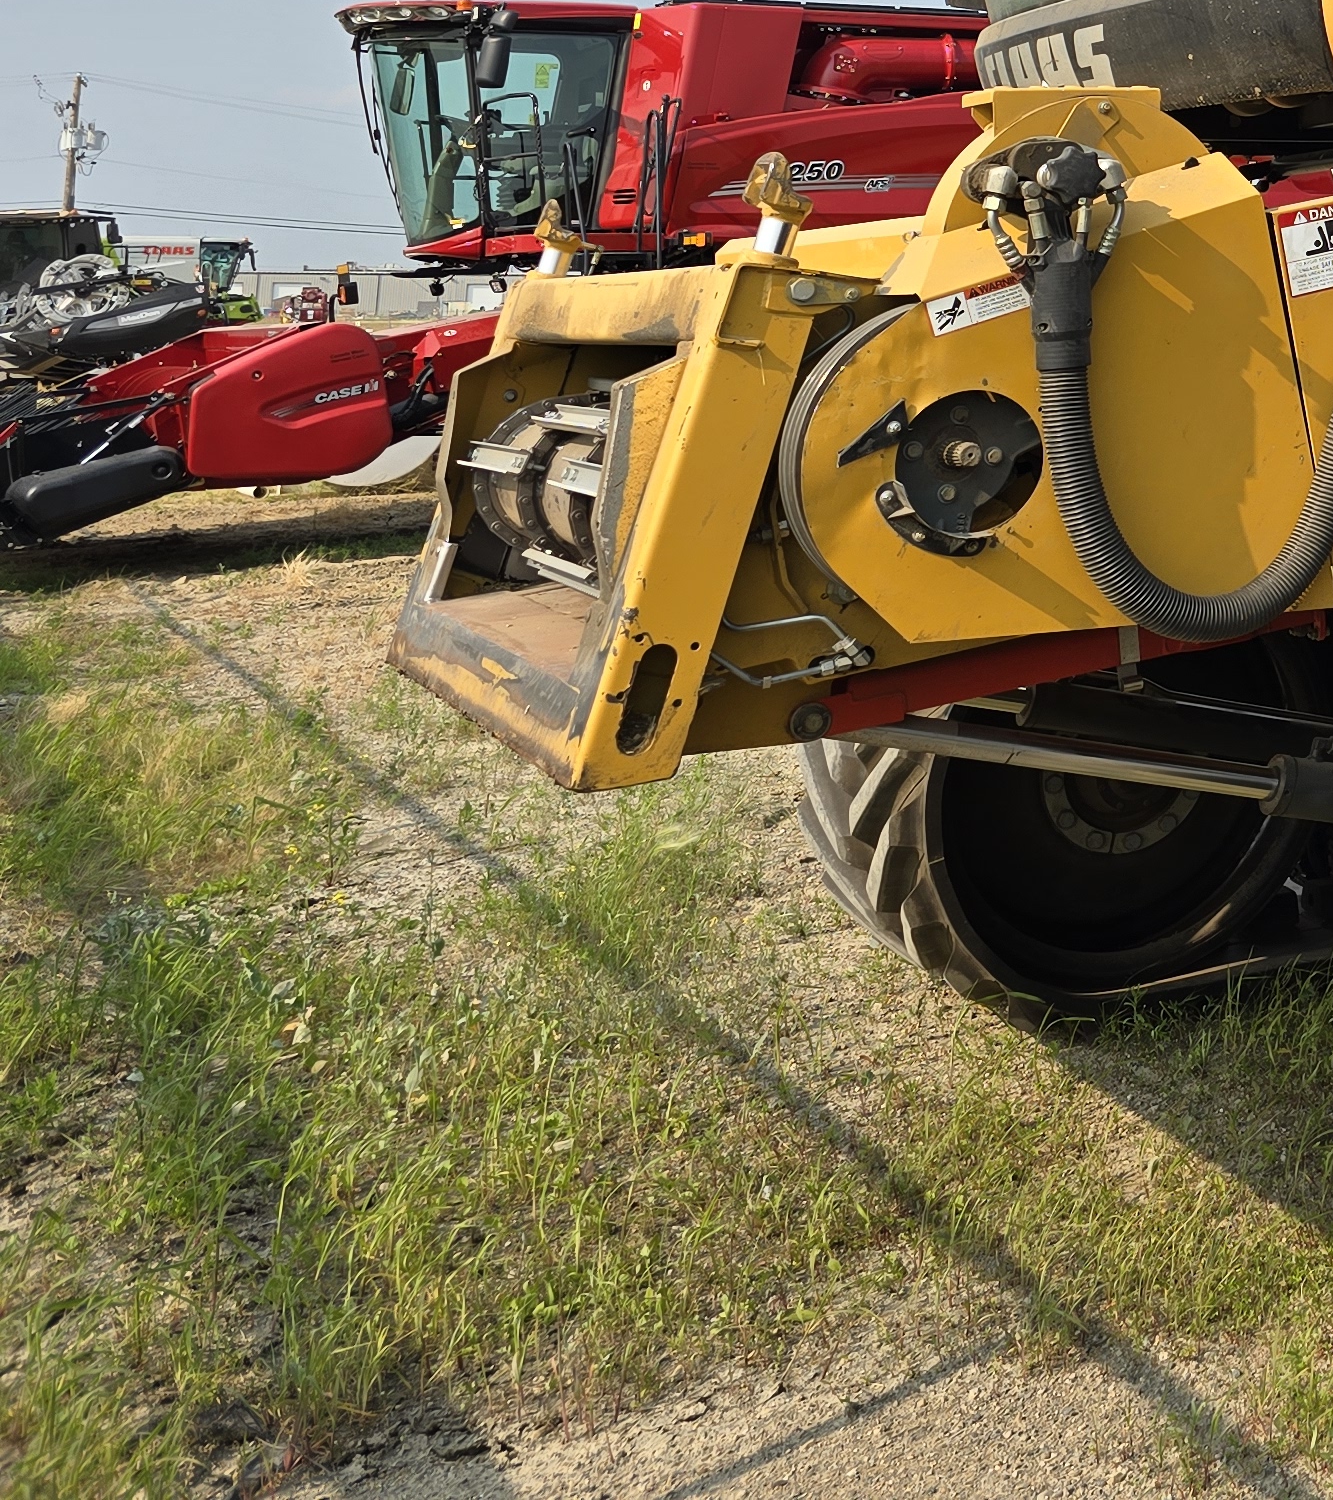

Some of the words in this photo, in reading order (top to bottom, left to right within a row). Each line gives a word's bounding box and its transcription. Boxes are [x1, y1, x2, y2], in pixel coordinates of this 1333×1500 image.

[143, 245, 195, 256] CLAAS
[979, 275, 1019, 295] WARNIN
[314, 384, 363, 404] CASE
